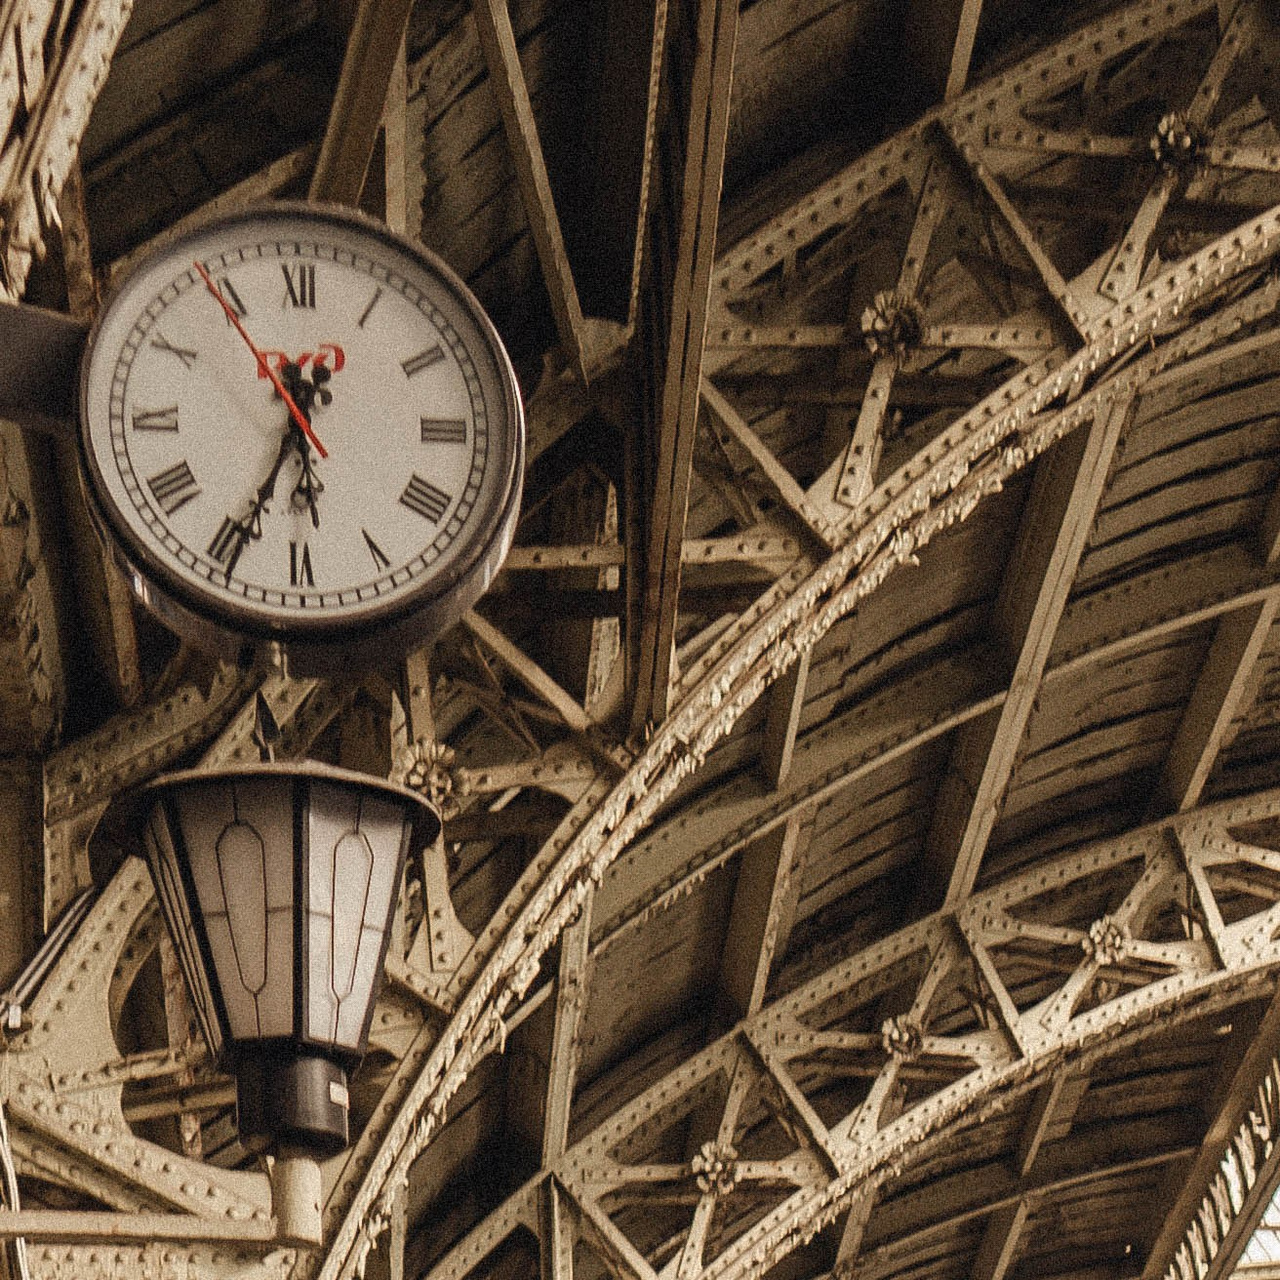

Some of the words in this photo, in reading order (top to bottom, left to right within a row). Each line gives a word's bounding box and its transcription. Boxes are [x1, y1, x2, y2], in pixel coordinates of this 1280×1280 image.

[282, 264, 316, 309] XII
[359, 287, 382, 330] I
[149, 334, 198, 369] X
[400, 345, 445, 378] II
[131, 405, 179, 433] IX
[420, 416, 467, 444] III
[146, 460, 201, 516] VIII
[288, 541, 315, 587] VI
[361, 528, 391, 572] V
